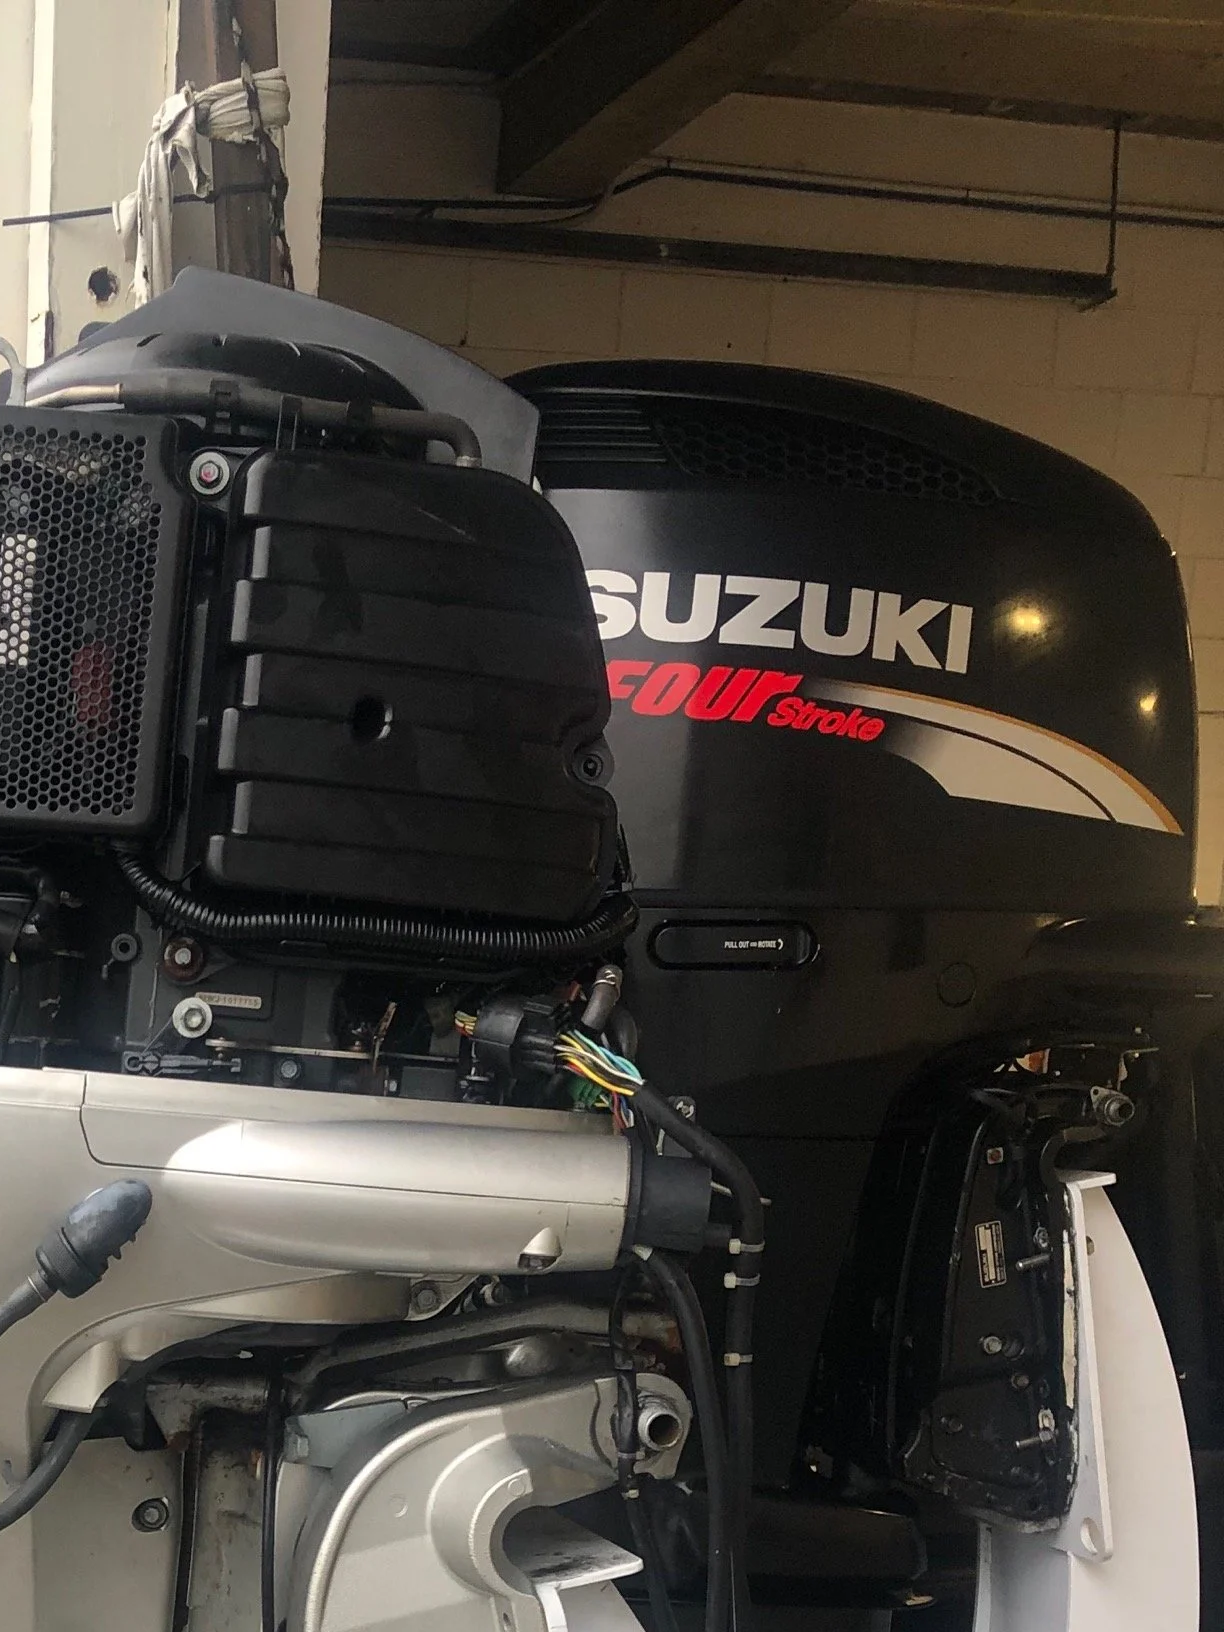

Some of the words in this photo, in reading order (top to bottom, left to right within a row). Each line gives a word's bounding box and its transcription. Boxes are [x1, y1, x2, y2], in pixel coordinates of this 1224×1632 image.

[587, 569, 974, 675] SUZUKI
[767, 695, 886, 742] Stroke
[738, 940, 749, 948] OUT
